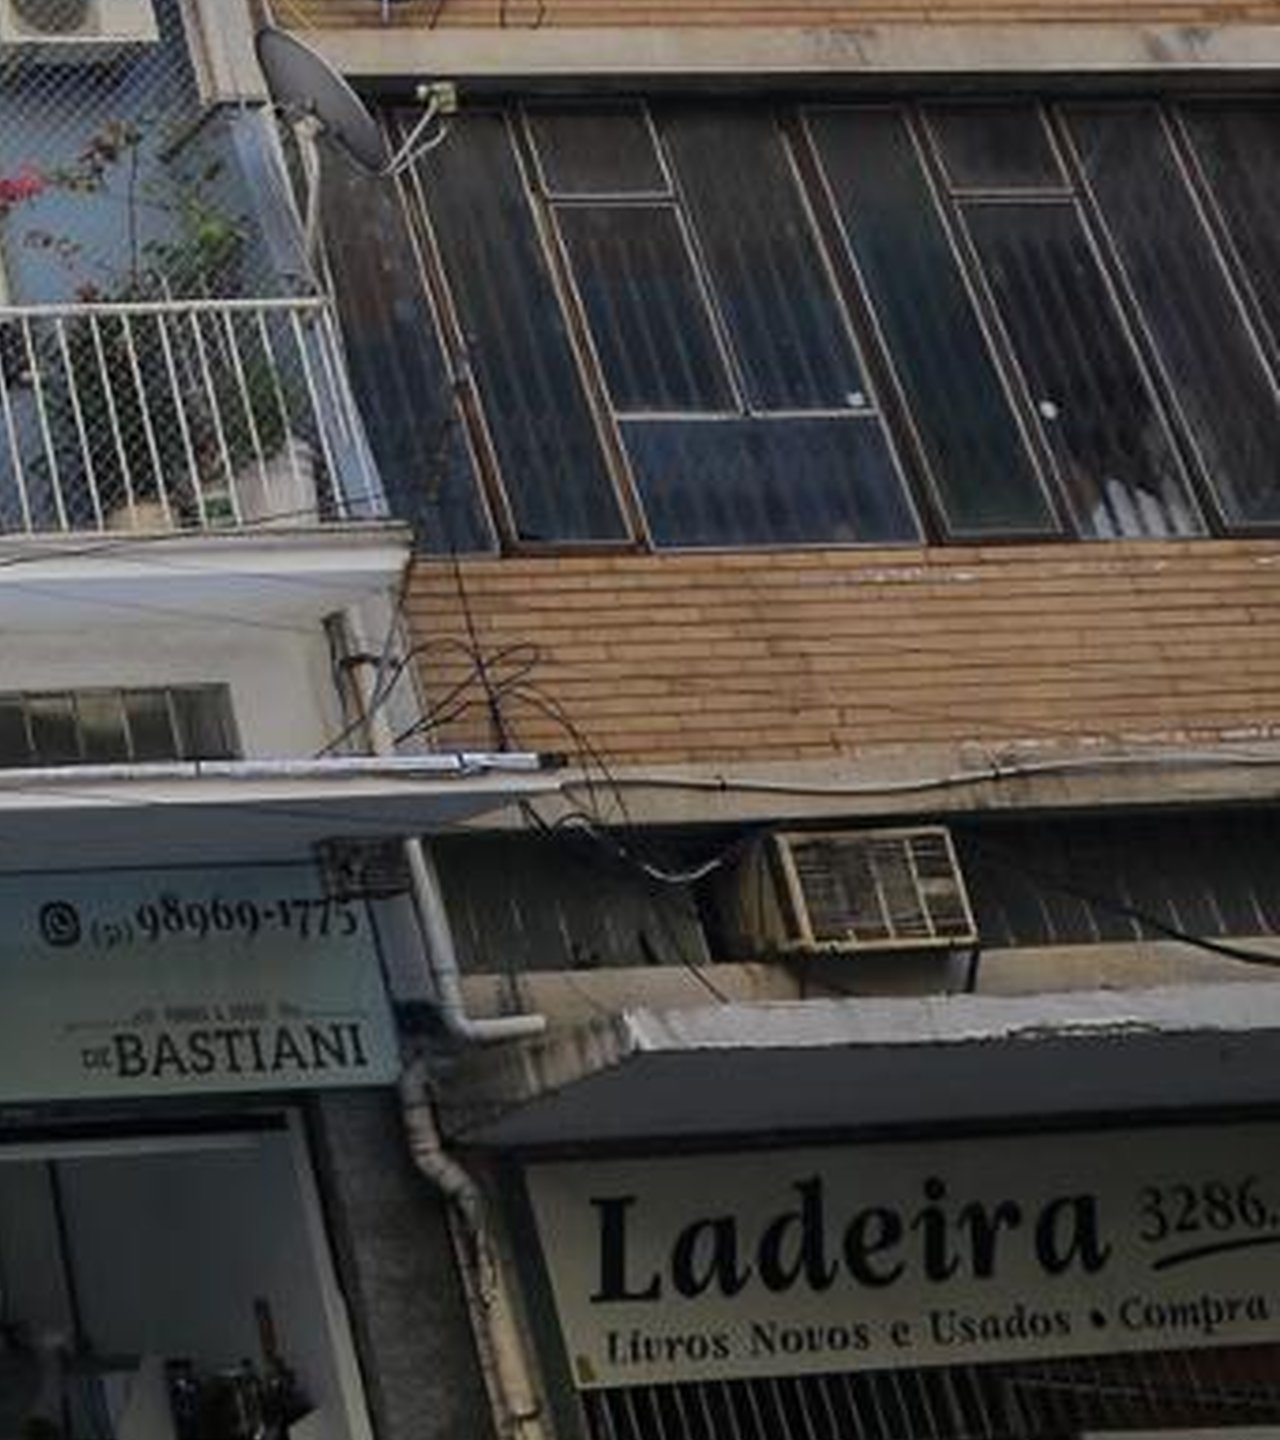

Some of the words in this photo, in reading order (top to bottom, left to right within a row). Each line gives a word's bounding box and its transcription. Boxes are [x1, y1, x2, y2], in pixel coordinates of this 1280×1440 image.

[113, 1023, 368, 1077] BASTIANI
[589, 1175, 1111, 1304] Ladeira
[606, 1325, 731, 1368] Livros
[748, 1319, 871, 1359] Novos
[890, 1323, 911, 1348] e
[929, 1302, 1072, 1347] Usados
[1118, 1293, 1268, 1334] Compra
